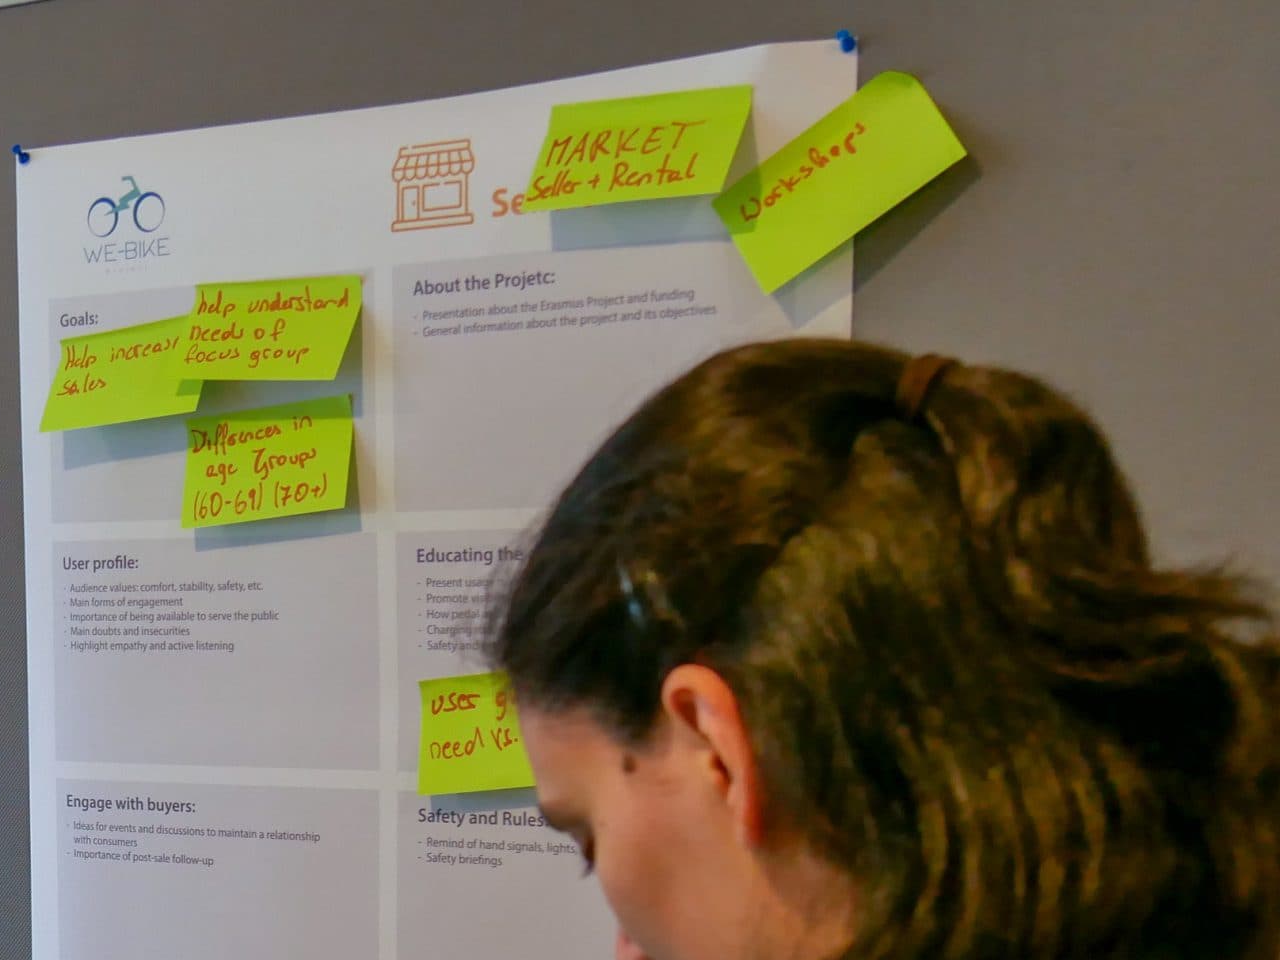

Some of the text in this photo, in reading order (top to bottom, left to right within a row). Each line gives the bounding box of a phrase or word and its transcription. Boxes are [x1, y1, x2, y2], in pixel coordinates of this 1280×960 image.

[546, 120, 707, 167] MARKET
[608, 152, 698, 192] Rental
[83, 238, 170, 263] WE-BIKE
[413, 279, 460, 296] About
[465, 276, 490, 291] the
[197, 285, 349, 317] help understand
[423, 306, 485, 321] Presentation
[488, 303, 518, 315] about
[521, 302, 537, 312] the
[587, 295, 624, 309] Project
[627, 291, 648, 304] and
[650, 288, 695, 304] funding
[60, 312, 98, 327] Goals:
[423, 304, 717, 337] General information about the project and its objectives
[254, 318, 285, 341] of
[184, 344, 310, 368] focus group
[292, 416, 312, 430] in
[62, 555, 139, 573] User profile:
[416, 547, 493, 566] Educating
[70, 583, 108, 593] Audience
[426, 577, 462, 588] Present
[70, 597, 183, 609] Main forms of engagement
[426, 594, 468, 603] Promote
[70, 611, 279, 624] Importance of being available to serve the public
[426, 609, 449, 619] How
[71, 626, 190, 636] Main doubts and insecurities
[71, 641, 234, 652] Highlight empathy and active listening
[427, 641, 457, 653] Safety
[66, 795, 196, 815] Engage with buyers:
[418, 808, 465, 827] Safety
[470, 812, 497, 824] and
[74, 821, 94, 831] Ideas
[96, 822, 106, 831] for
[109, 825, 136, 833] events
[138, 824, 154, 833] and
[156, 825, 205, 836] discussions
[207, 828, 216, 836] to
[218, 828, 256, 839] maintain
[266, 831, 320, 843] relationship
[74, 836, 137, 847] with consumers
[427, 837, 464, 849] Remind
[467, 839, 476, 848] of
[480, 840, 505, 850] hand
[74, 850, 214, 867] Importance of post-sale follow-up
[427, 853, 503, 868] Safety briefings
